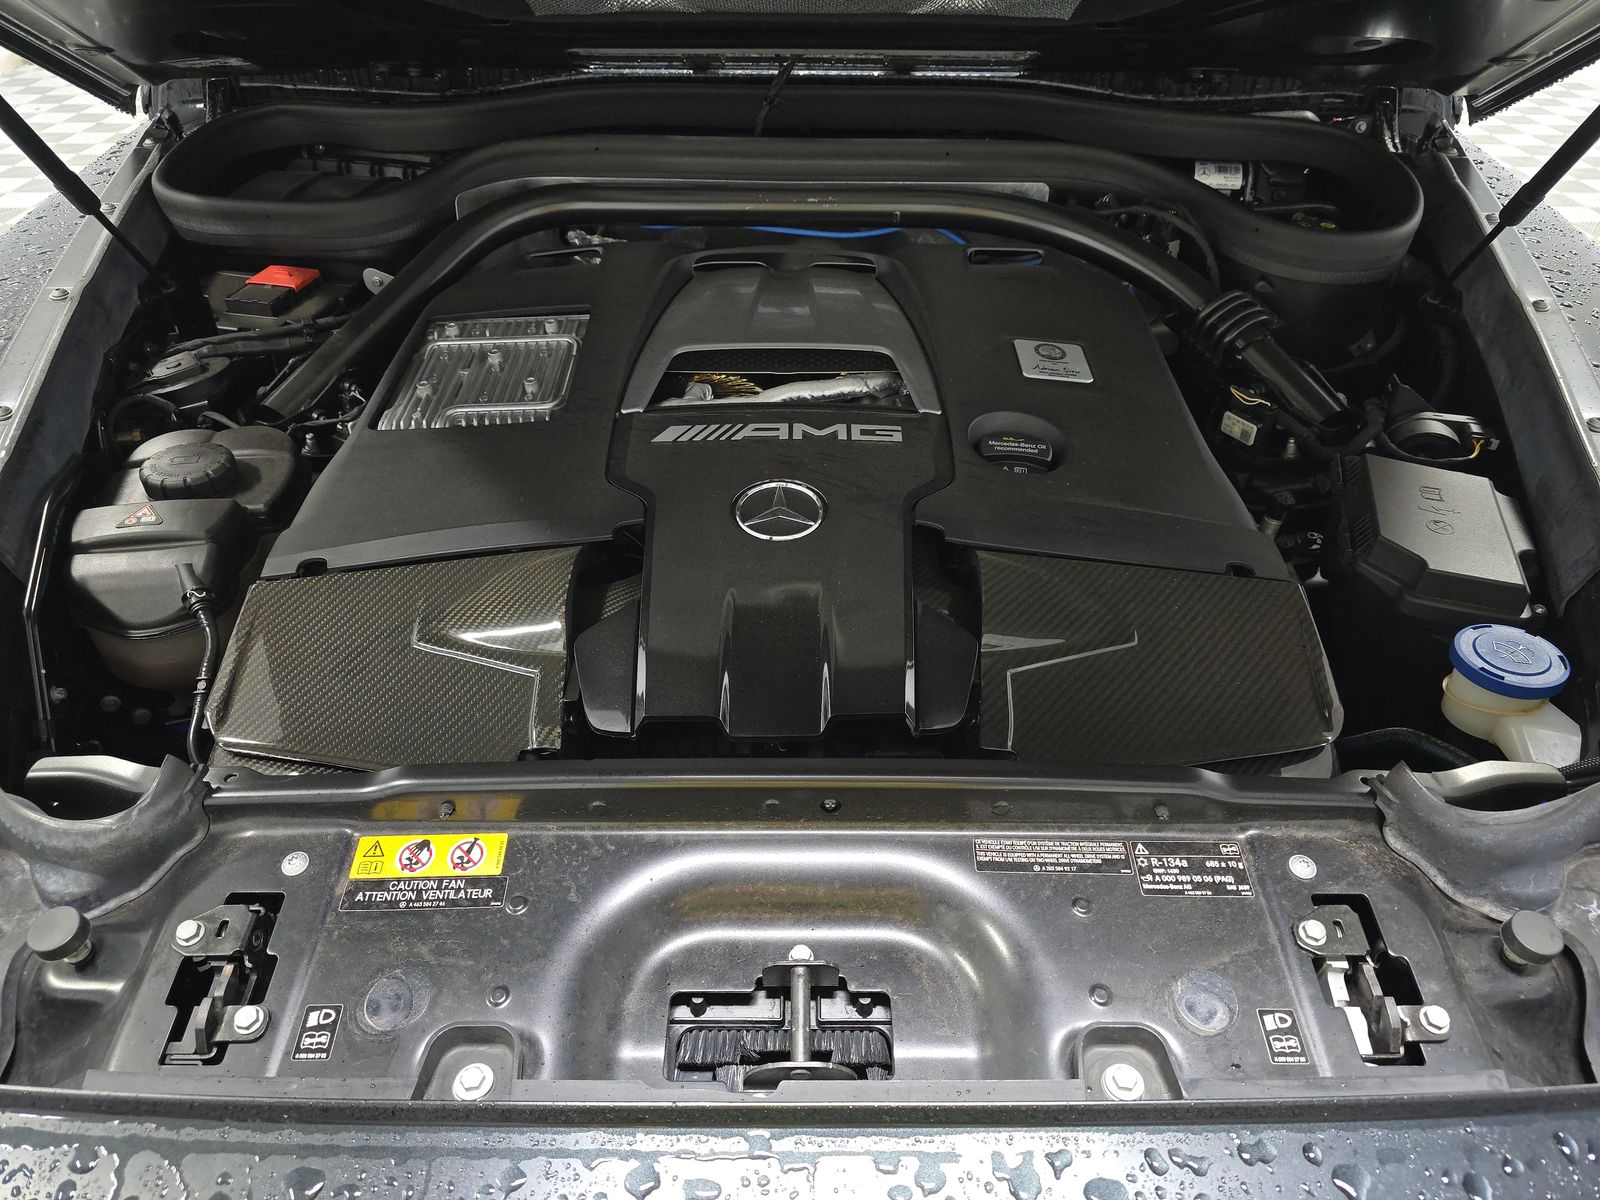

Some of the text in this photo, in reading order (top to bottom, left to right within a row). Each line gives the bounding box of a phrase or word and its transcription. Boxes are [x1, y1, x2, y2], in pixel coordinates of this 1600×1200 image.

[731, 423, 902, 442] AMG
[988, 440, 1036, 449] Mercedes-Benz
[1151, 858, 1188, 867] R-134a
[1214, 876, 1234, 884] (PAG)
[389, 880, 465, 890] CAUTION FAN
[355, 889, 492, 902] ATTENTION VENTILATEUR
